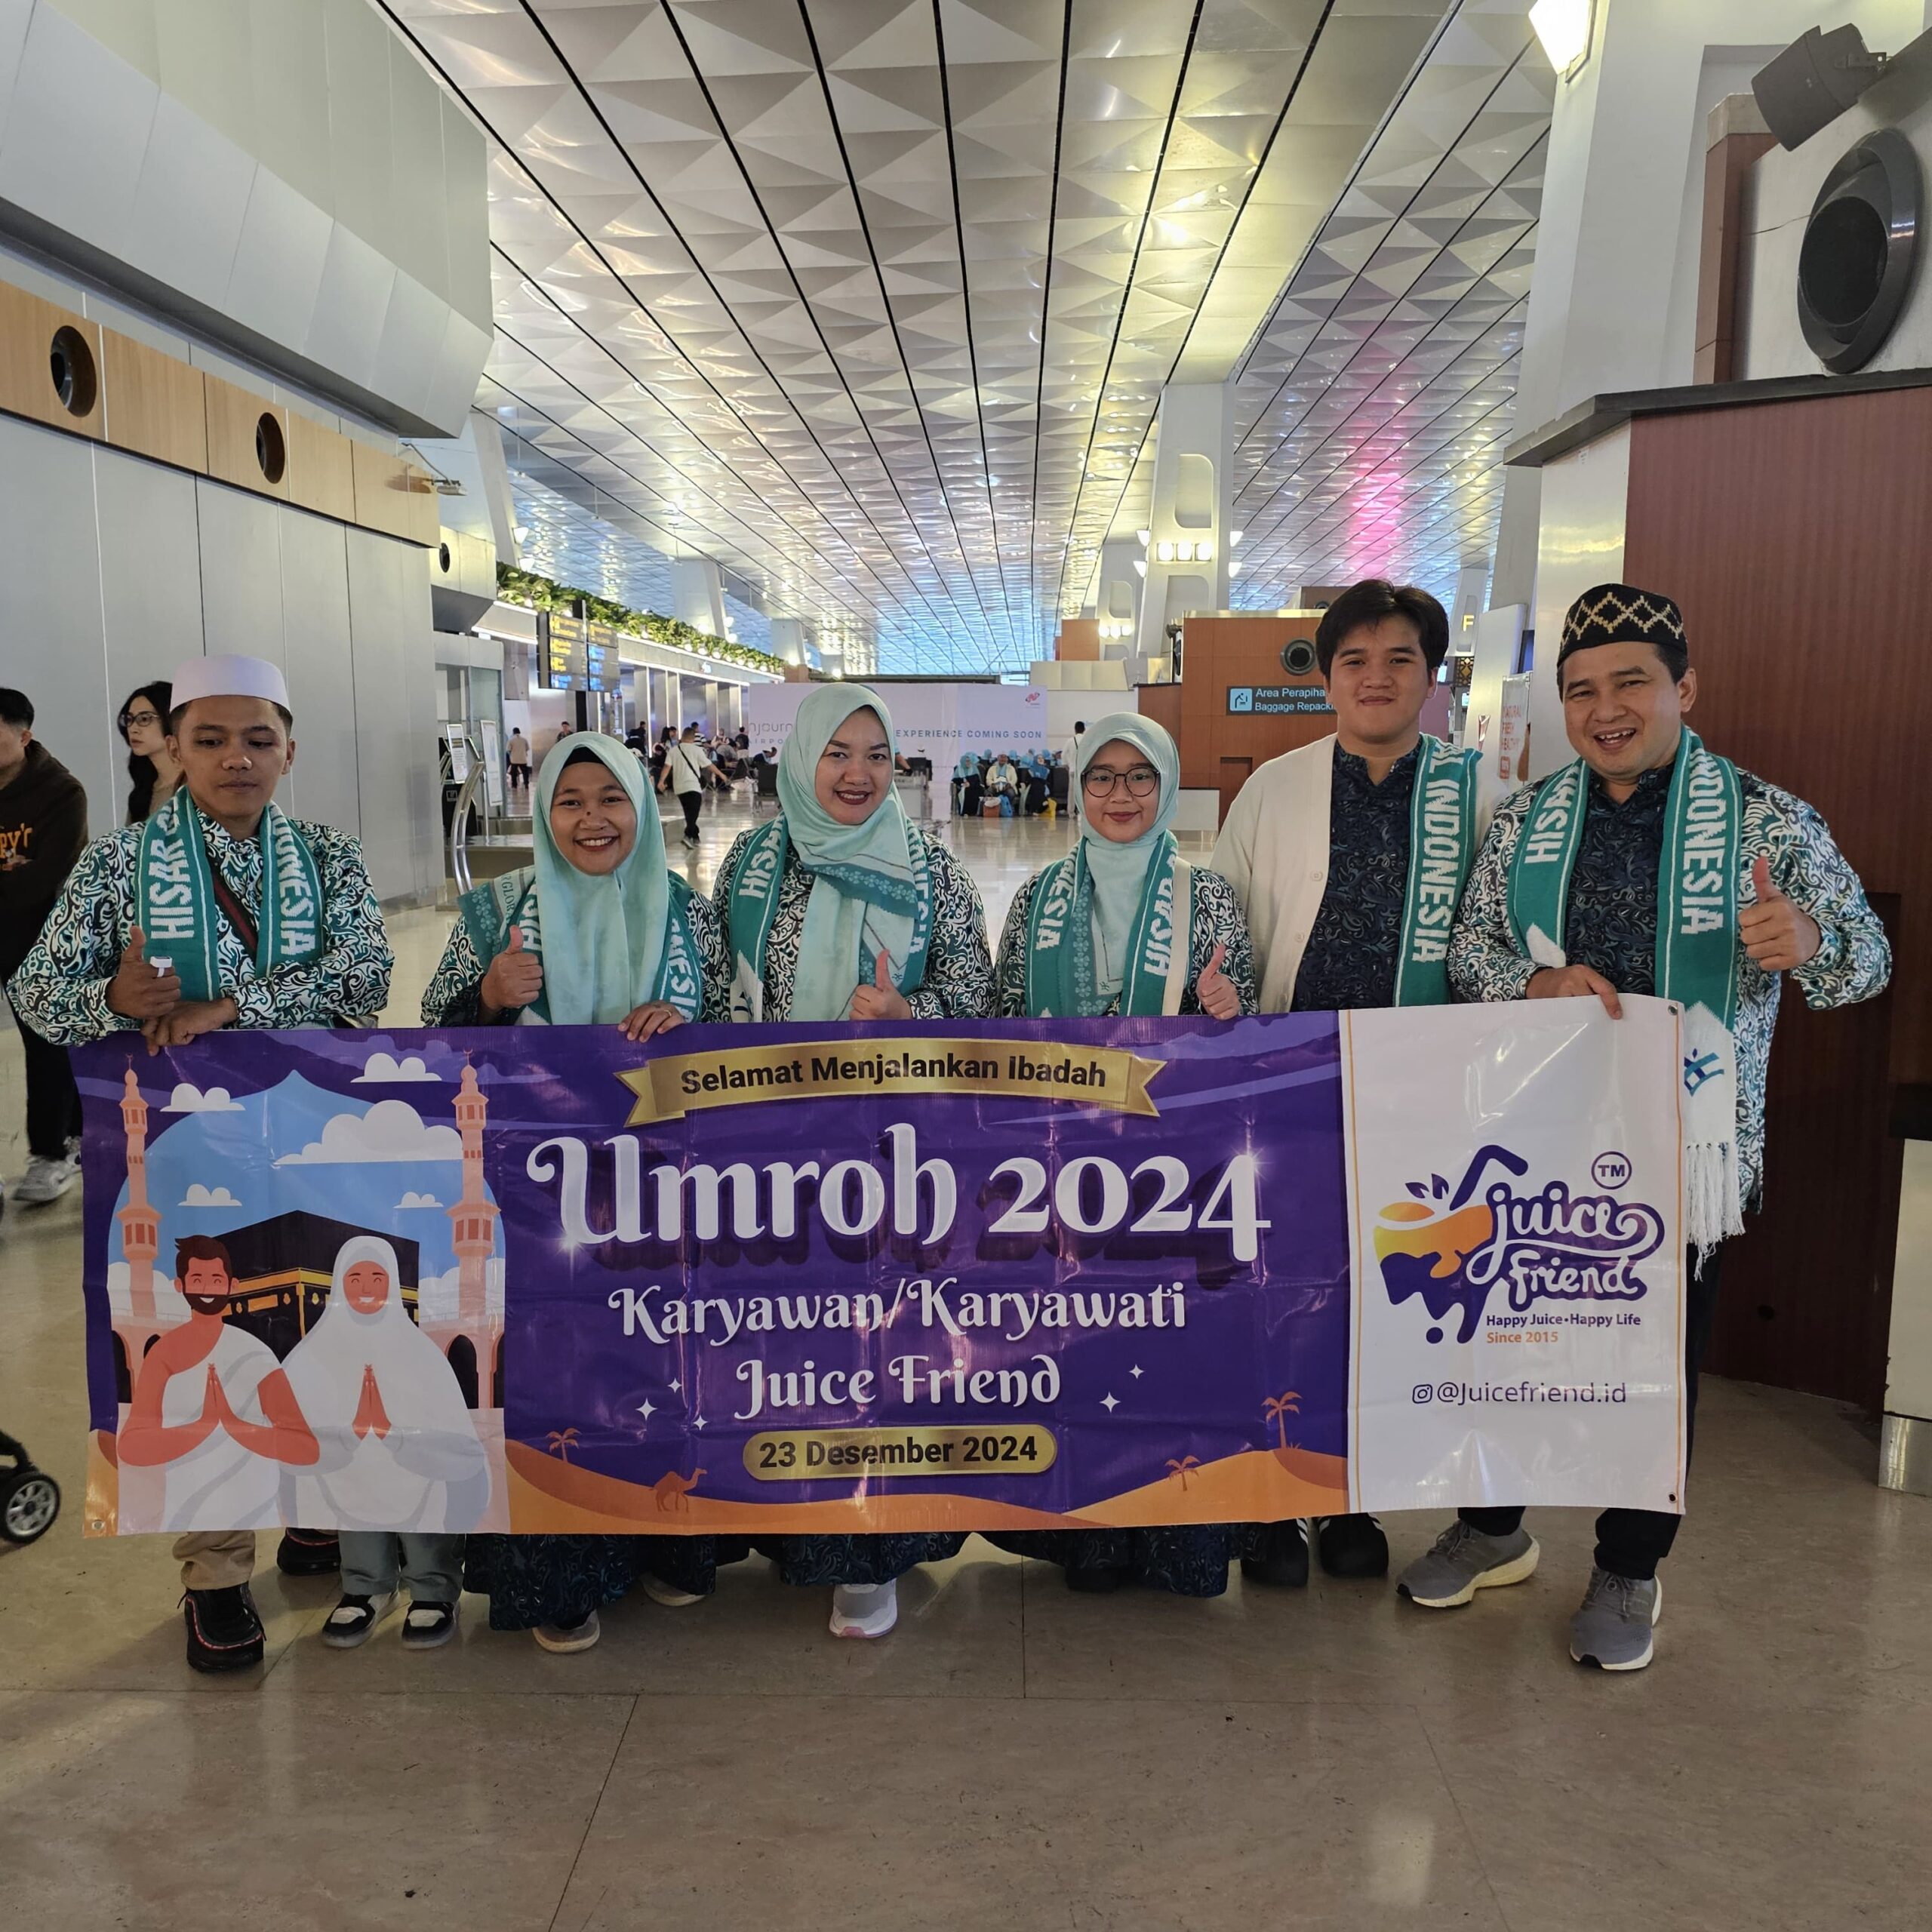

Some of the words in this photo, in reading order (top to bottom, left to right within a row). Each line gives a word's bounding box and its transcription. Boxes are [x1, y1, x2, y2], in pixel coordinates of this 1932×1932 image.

[1463, 615, 1474, 632] F
[1255, 702, 1295, 712] Baggage
[1256, 688, 1279, 697] Area
[967, 730, 1010, 738] COMING
[1412, 779, 1460, 962] INDONESIA
[148, 838, 195, 939] HISAR
[681, 1060, 804, 1094] Selamat
[811, 1053, 998, 1085] Menjalankan
[1008, 1055, 1106, 1088] Ibadah
[527, 1122, 957, 1244] Umroh
[989, 1155, 1272, 1262] 2024
[608, 1277, 1185, 1346] Karyawan/Karyawati
[1486, 1315, 1527, 1328] Happy
[1617, 1314, 1641, 1325] Life
[1487, 1332, 1521, 1343] Since
[1526, 1331, 1558, 1343] 2015
[734, 1359, 875, 1420] Juice
[888, 1355, 1061, 1407] Friend
[1437, 1381, 1627, 1406] @Juicefriend.id
[759, 1441, 796, 1468] 23
[806, 1437, 954, 1466] Desember
[962, 1435, 1038, 1463] 2024
